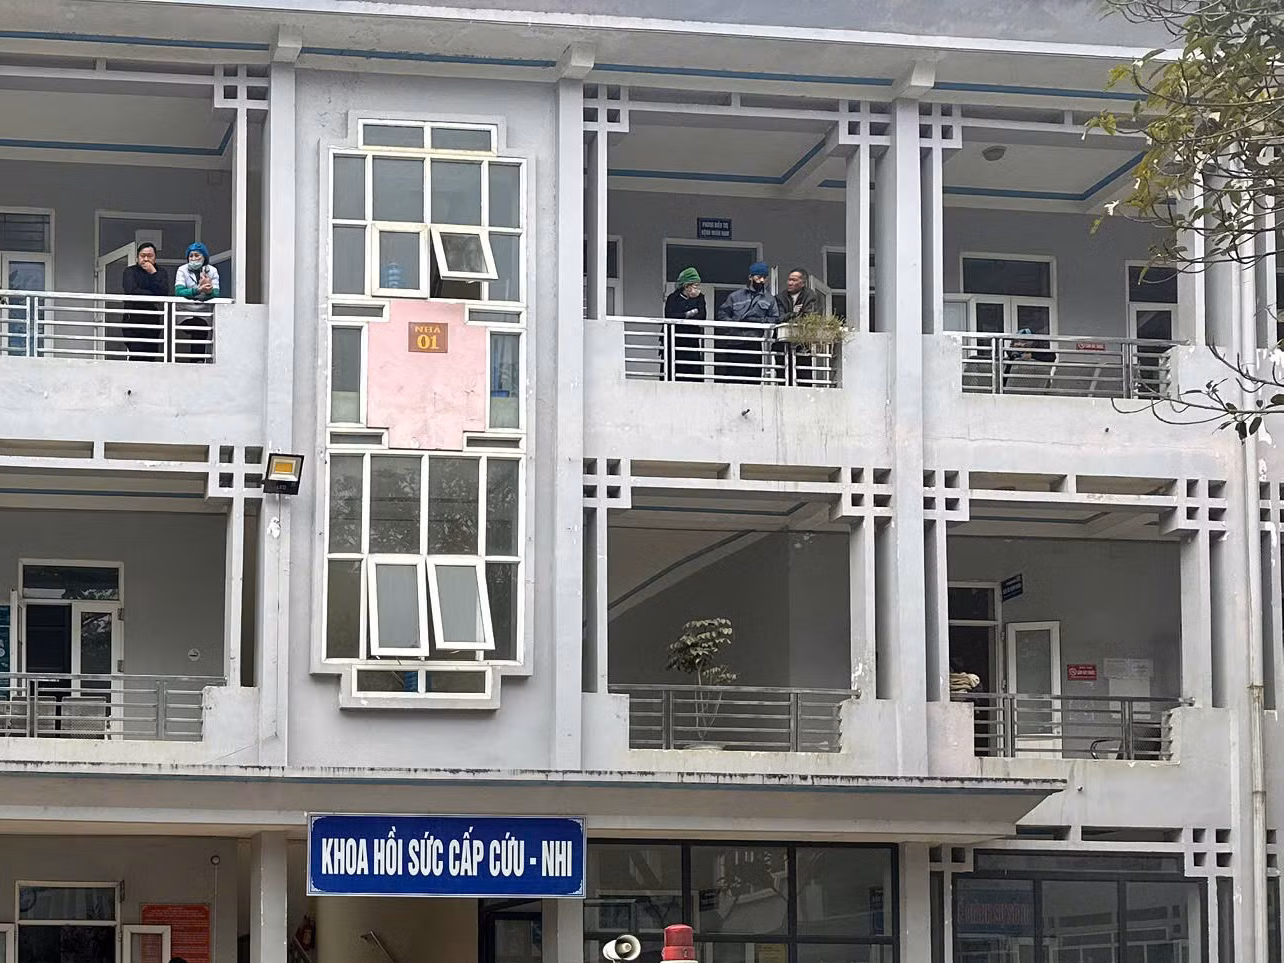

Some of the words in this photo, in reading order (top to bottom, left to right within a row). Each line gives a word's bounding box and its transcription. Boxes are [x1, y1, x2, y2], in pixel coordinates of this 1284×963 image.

[417, 334, 440, 350] 01
[321, 838, 369, 876] KHOA
[373, 826, 403, 876] HỒI
[407, 831, 444, 877] SỨC
[448, 826, 485, 877] CẤP
[489, 831, 525, 877] CỨU
[541, 840, 573, 877] NHI
